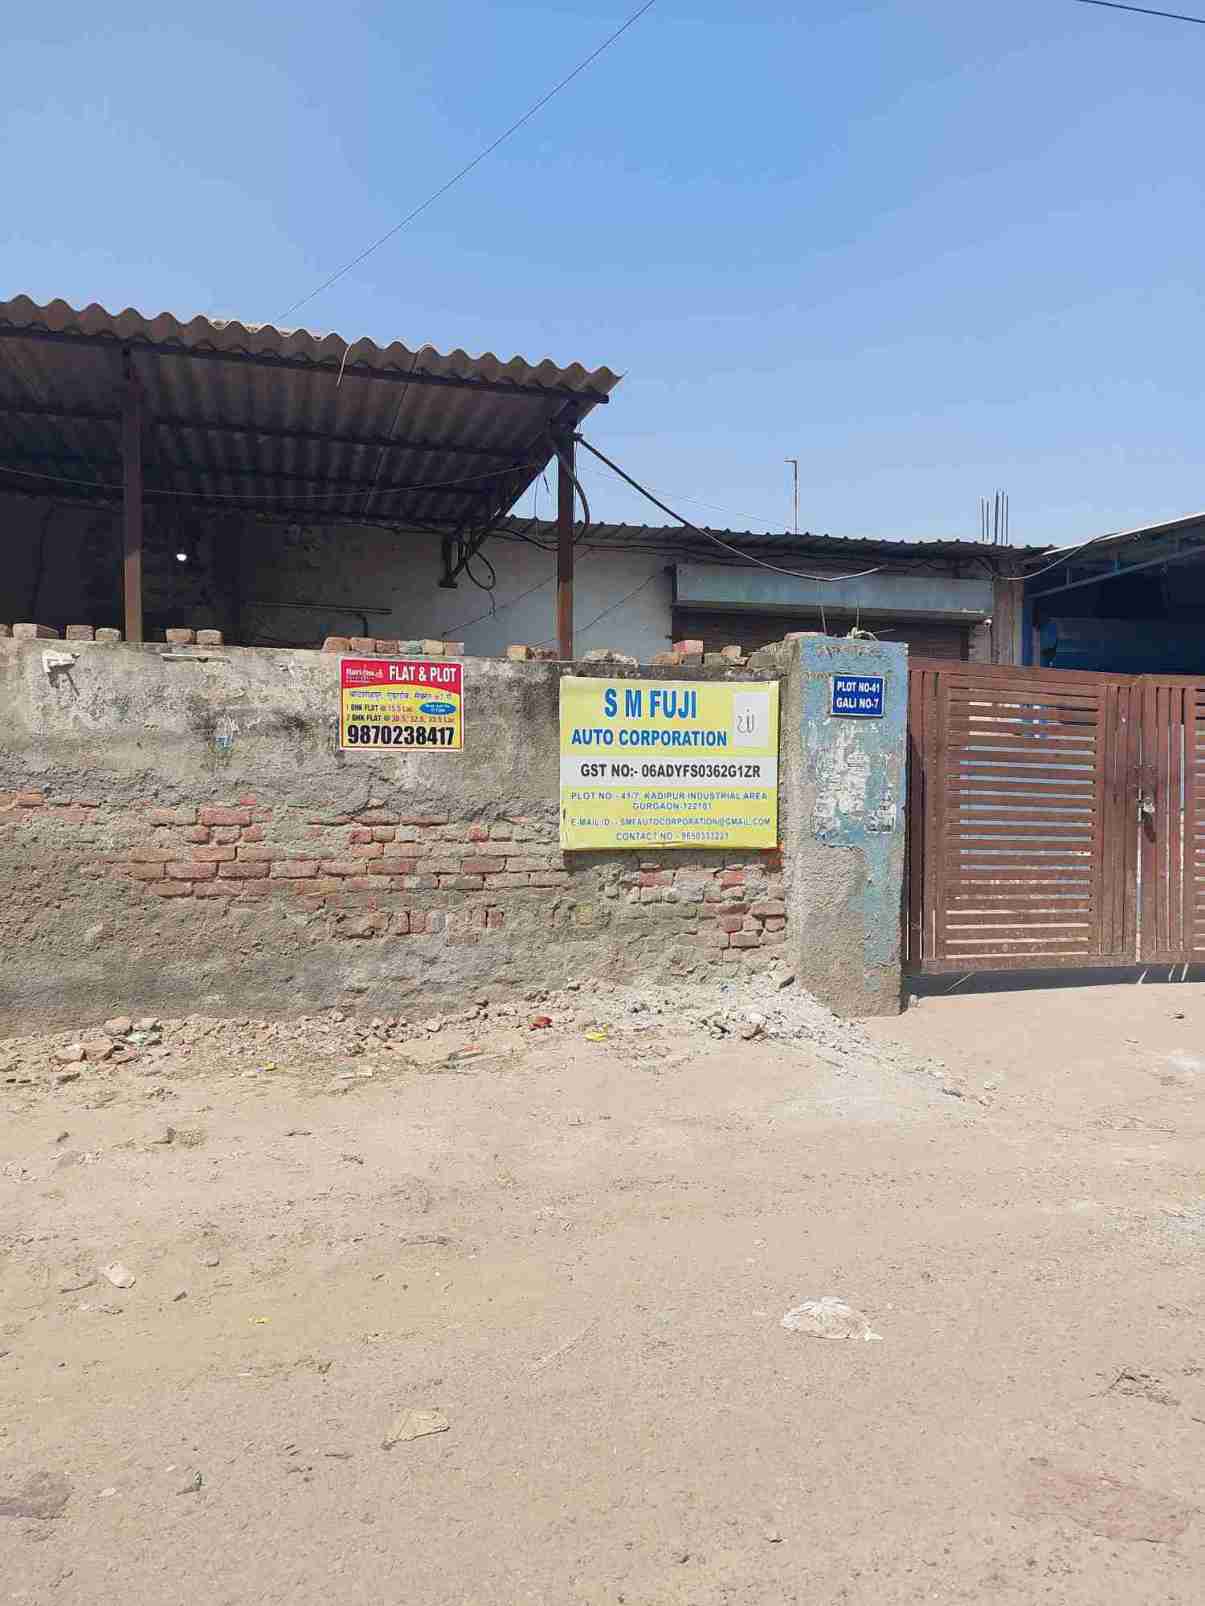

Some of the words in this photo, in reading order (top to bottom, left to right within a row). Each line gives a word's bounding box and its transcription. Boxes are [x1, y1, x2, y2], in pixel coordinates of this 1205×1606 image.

[389, 665, 416, 681] FLAT
[418, 667, 426, 682] &
[430, 666, 456, 682] PLOT
[837, 681, 857, 692] PLOT
[858, 682, 880, 693] NO-41
[604, 688, 618, 718] S
[625, 689, 642, 718] M
[650, 690, 697, 719] FUJI
[836, 698, 857, 708] GALI
[860, 698, 879, 709] NO-7
[348, 724, 455, 745] 9870238417
[571, 729, 614, 745] AUTO
[619, 730, 728, 746] CORPORATION
[580, 763, 608, 777] GST
[612, 764, 638, 778] NO:-
[642, 764, 760, 778] 06ADYFS0362G1ZR
[571, 792, 594, 800] PLOT
[644, 792, 685, 800] KADIPUR
[688, 792, 740, 800] INDUSTRIAL
[743, 792, 768, 800] AREA
[616, 832, 659, 840] CONTACT
